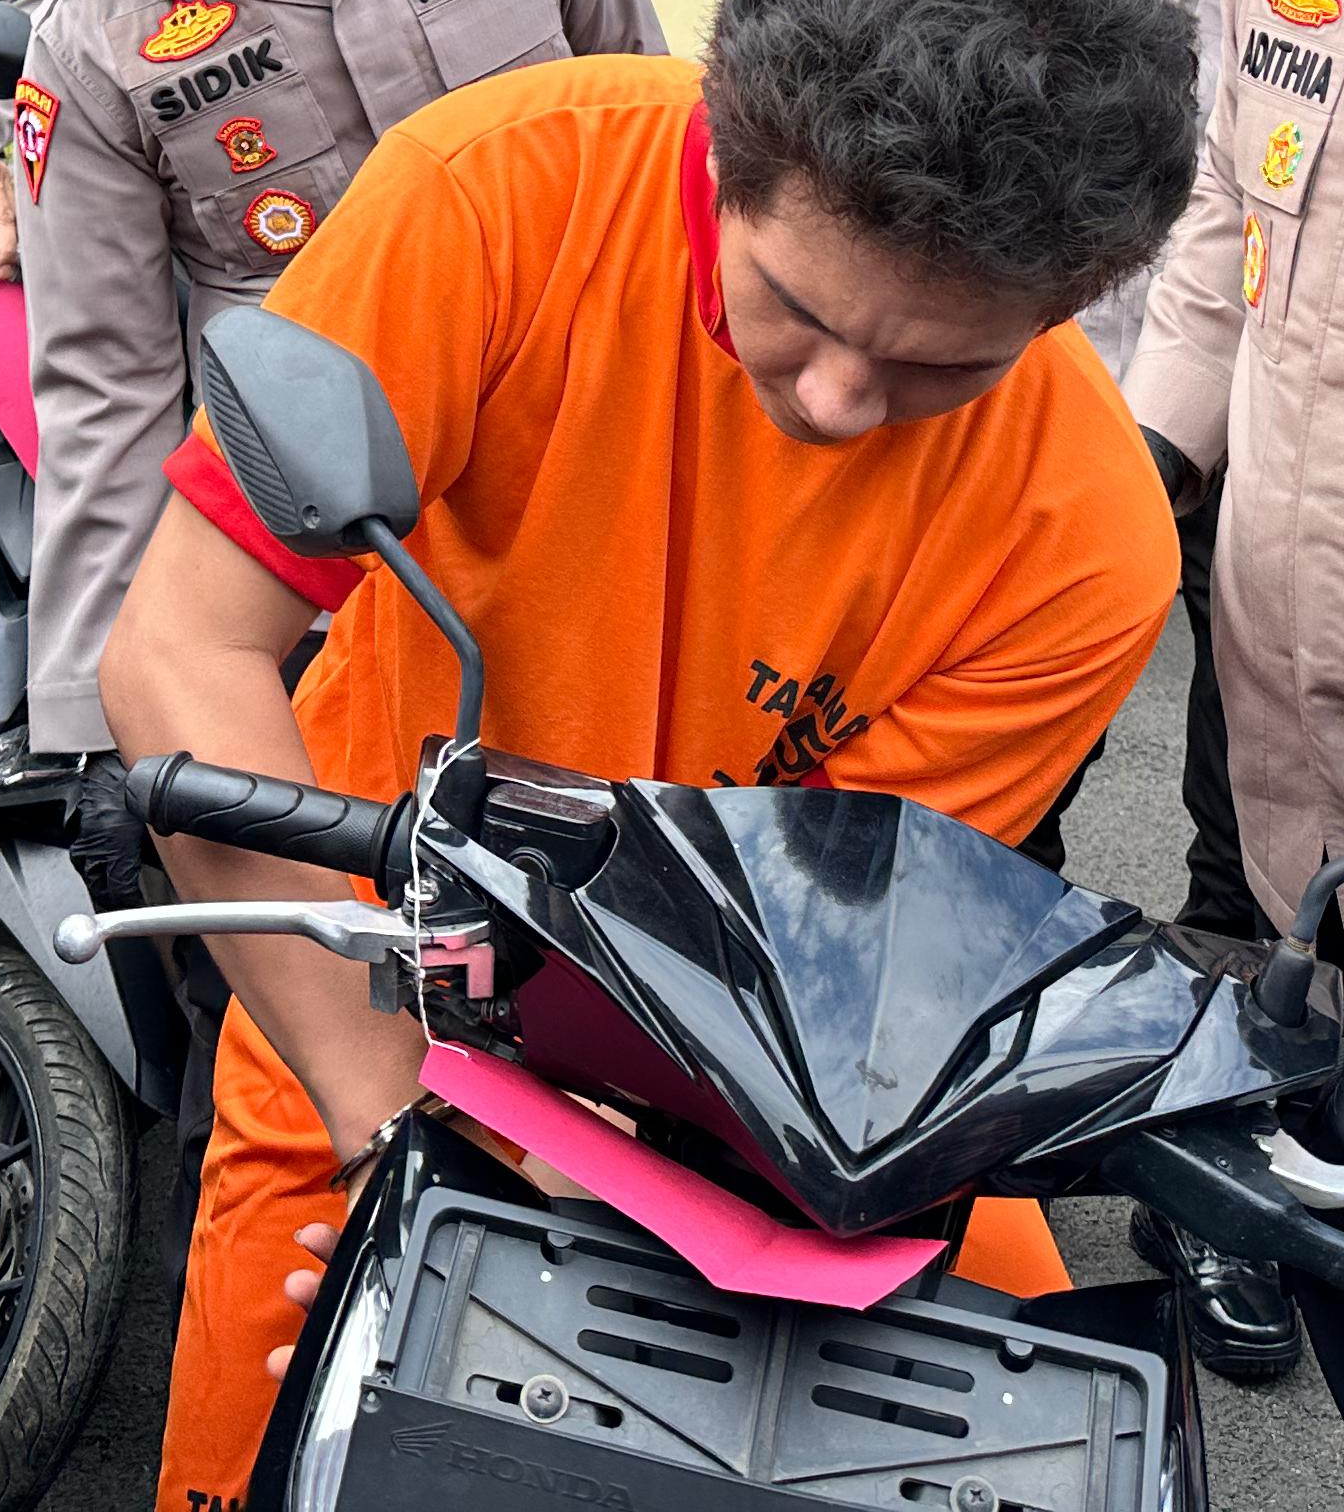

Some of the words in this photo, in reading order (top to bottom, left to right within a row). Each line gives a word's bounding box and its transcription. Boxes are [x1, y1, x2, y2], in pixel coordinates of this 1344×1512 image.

[150, 38, 284, 122] SIDIK
[1240, 28, 1333, 104] ADITHIA
[447, 1439, 635, 1511] HONDA
